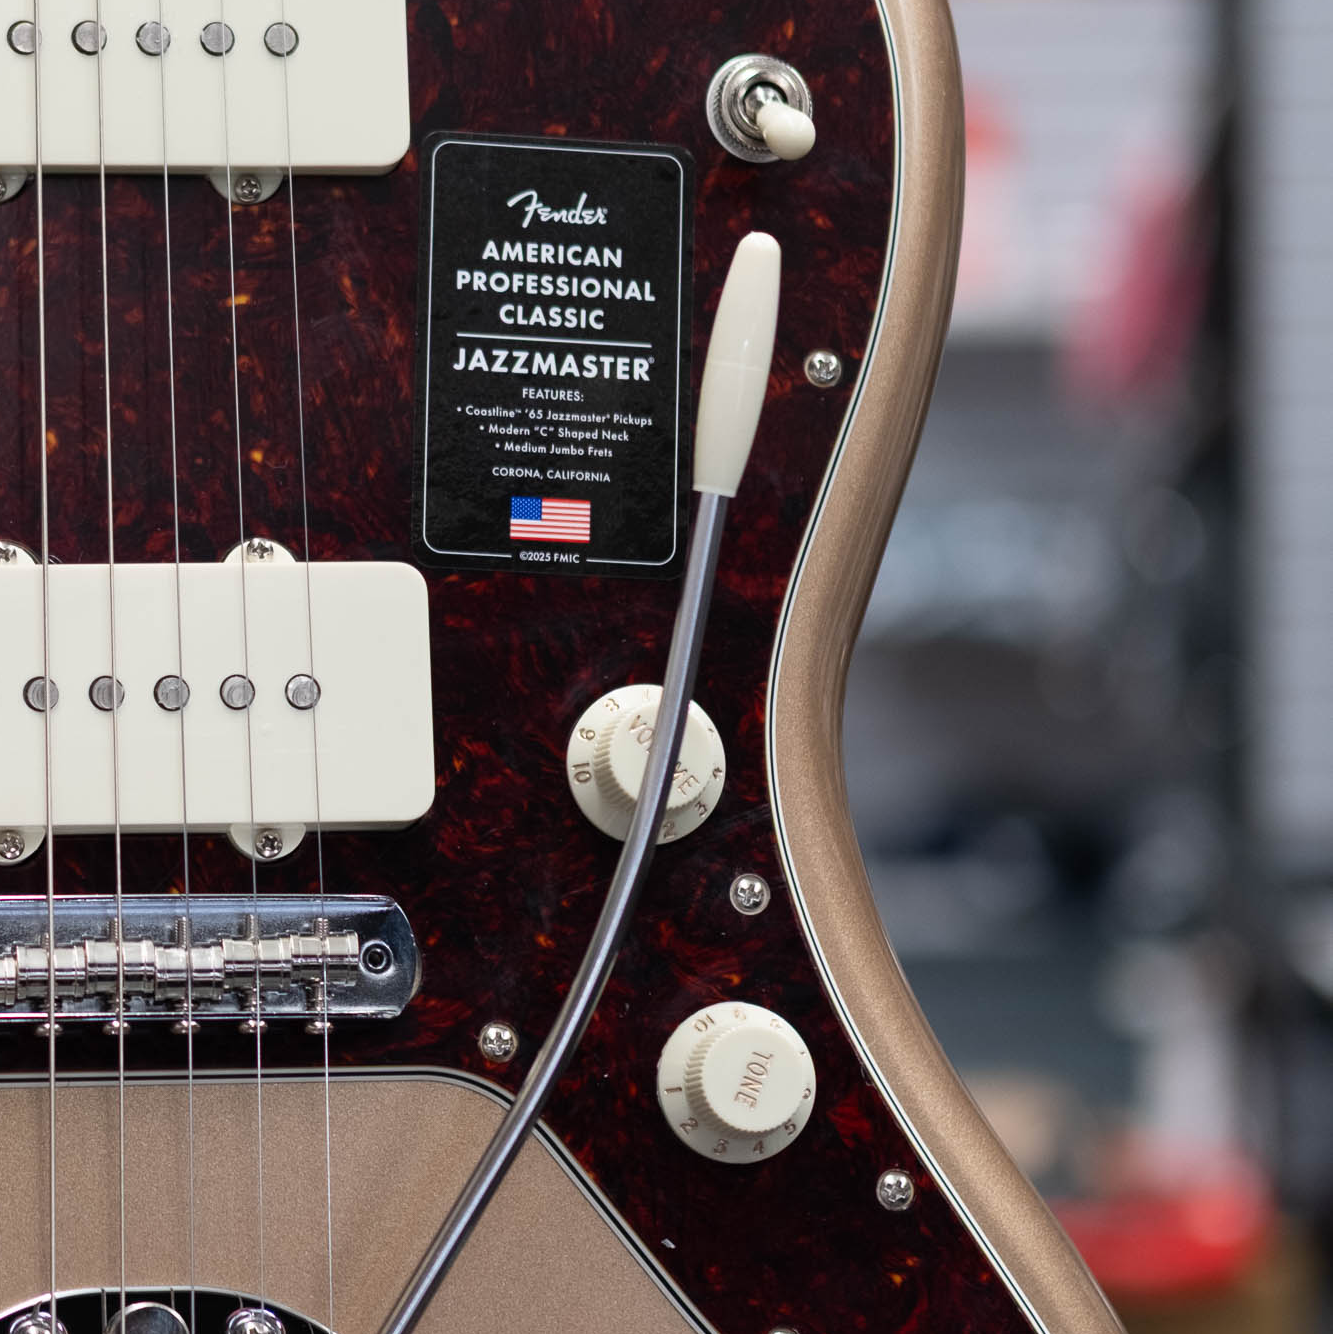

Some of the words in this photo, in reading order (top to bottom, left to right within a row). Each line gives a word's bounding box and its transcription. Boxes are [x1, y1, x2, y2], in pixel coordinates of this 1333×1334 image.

[481, 240, 622, 268] AMERICAN
[456, 270, 656, 302] PROFESSIONAL
[499, 304, 605, 330] CLASSIC
[522, 388, 584, 402] FEATURES:
[525, 408, 543, 419] '65
[613, 414, 652, 427] Pickups
[488, 424, 530, 436] Modern
[558, 428, 598, 440] Shaped
[601, 430, 629, 442] Neck
[504, 442, 546, 454] Medium
[550, 444, 584, 456] Jumbo
[588, 446, 613, 458] Frets
[492, 467, 543, 480] CORONA,
[547, 470, 611, 483] CALIFORNIA
[554, 553, 580, 564] FMIC
[734, 1051, 774, 1110] TONE
